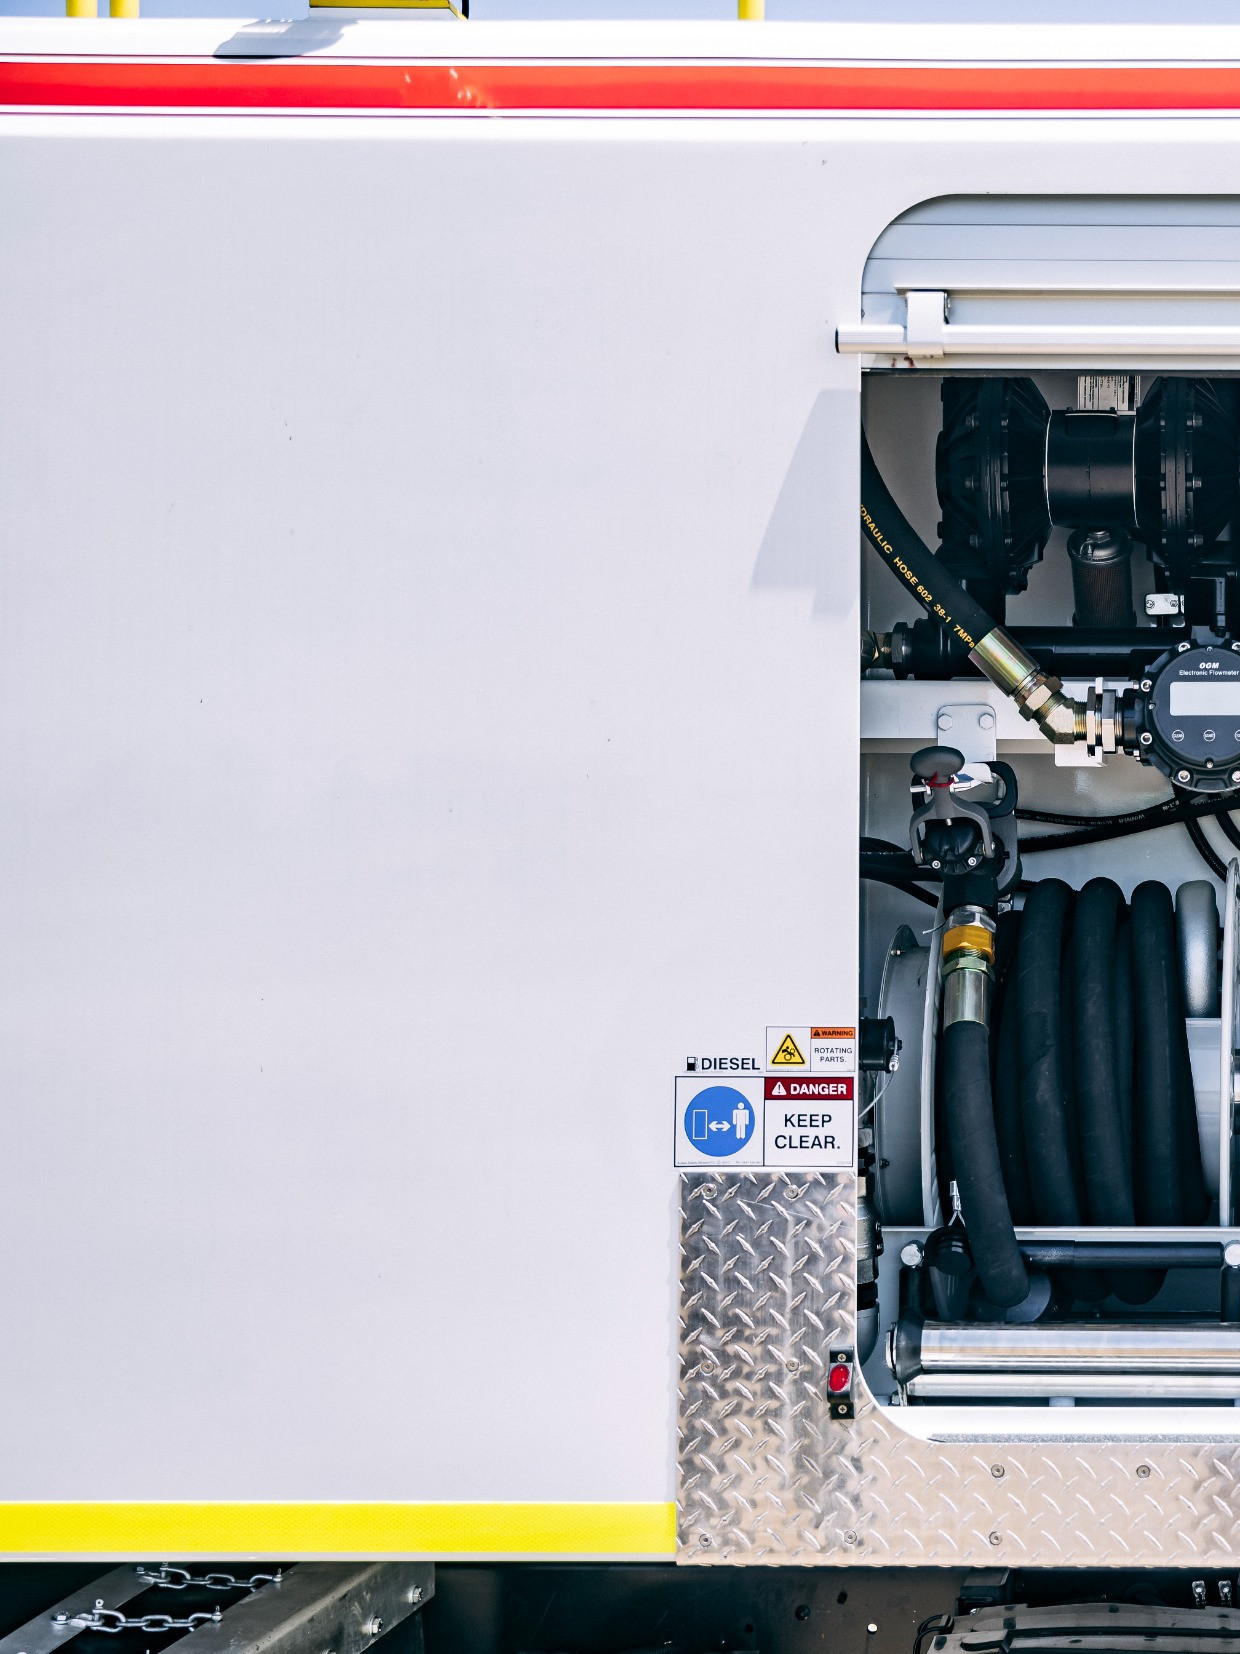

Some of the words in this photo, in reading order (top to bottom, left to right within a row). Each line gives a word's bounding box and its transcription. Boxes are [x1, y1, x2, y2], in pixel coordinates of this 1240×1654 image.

[860, 505, 893, 554] DRAULIC
[893, 556, 919, 586] HOSE
[916, 585, 933, 603] 602
[933, 603, 952, 623] 38-1
[953, 624, 976, 649] 7MPa
[701, 1057, 761, 1071] DIESEL
[790, 1083, 847, 1095] DANGER
[784, 1113, 832, 1128] KEEP
[774, 1135, 841, 1150] CLEAR.
